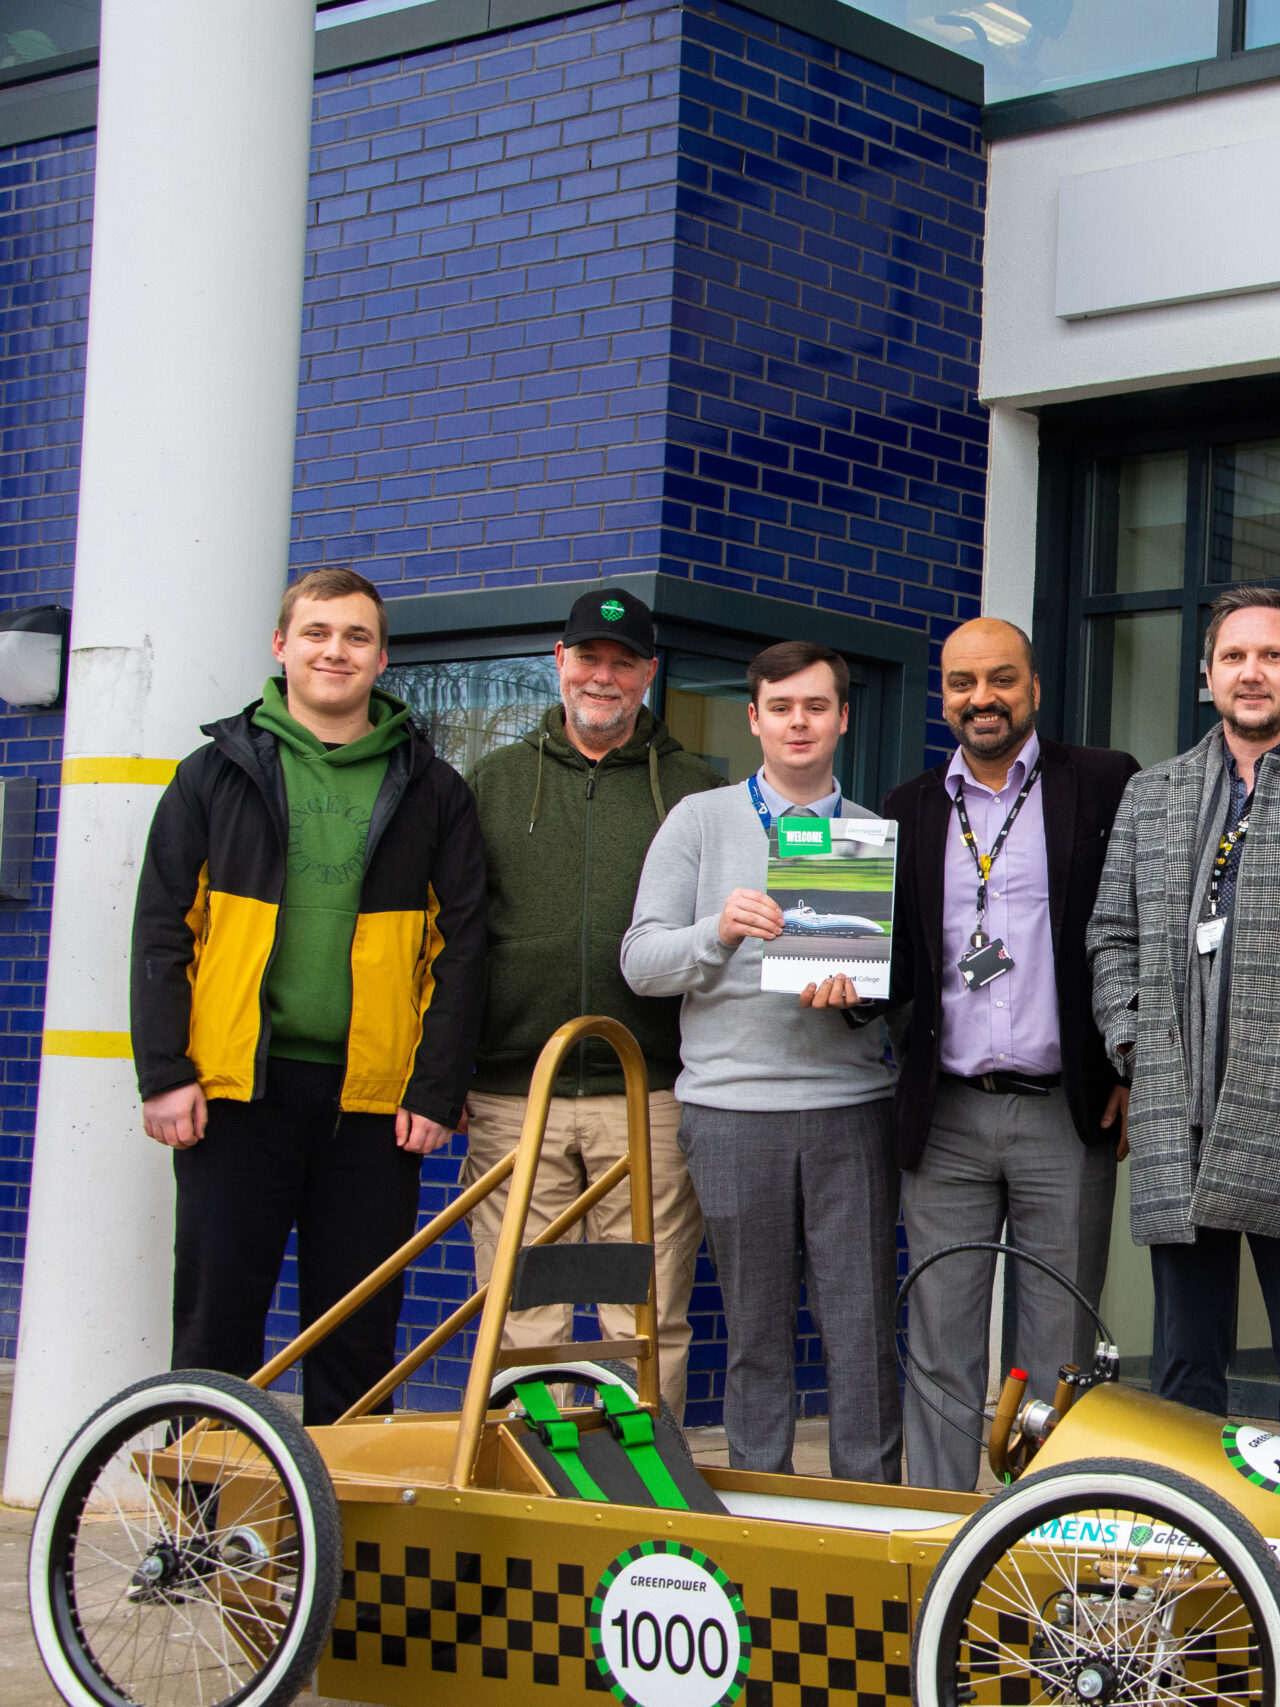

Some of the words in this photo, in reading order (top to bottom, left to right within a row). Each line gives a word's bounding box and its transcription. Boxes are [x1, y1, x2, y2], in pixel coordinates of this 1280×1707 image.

[786, 831, 824, 843] WELCOME
[630, 1575, 707, 1593] GREENPOWER
[611, 1609, 729, 1679] 1000
